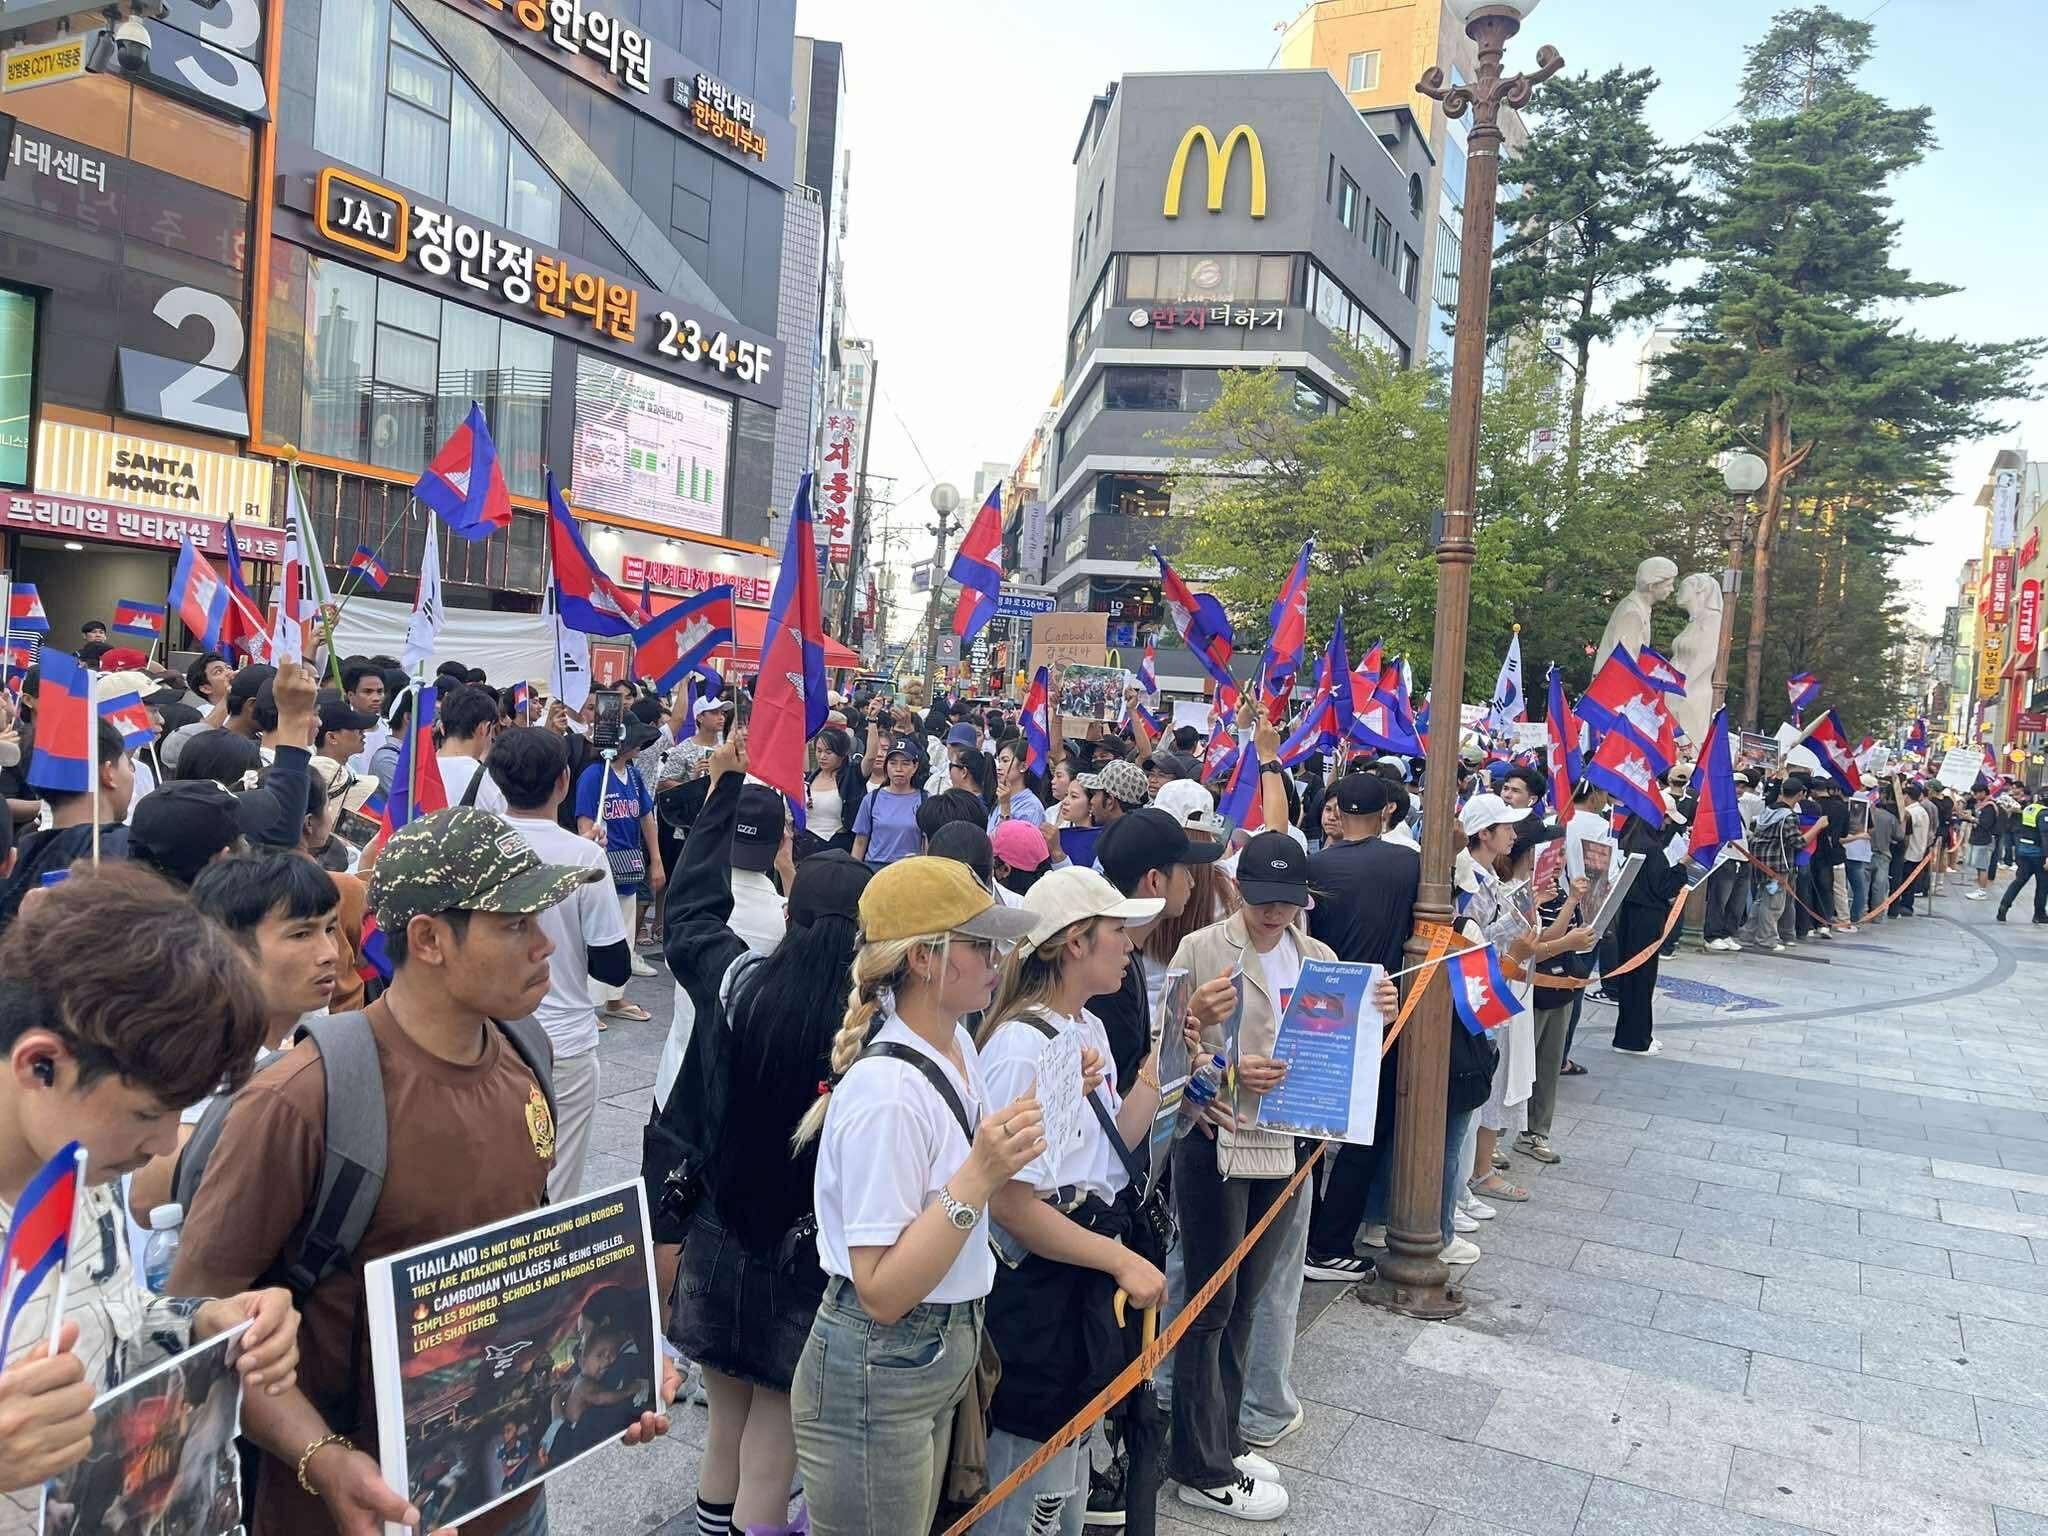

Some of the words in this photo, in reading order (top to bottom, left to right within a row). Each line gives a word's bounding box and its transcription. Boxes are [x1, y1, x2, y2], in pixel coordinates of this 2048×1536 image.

[697, 73, 755, 129] 한방내과
[695, 100, 767, 161] 한방피부과
[413, 204, 638, 343] 정안정한의원
[107, 471, 200, 501] MONICA
[115, 450, 194, 479] SANTA
[7, 497, 108, 534] 프리미엄
[223, 535, 252, 554] 하
[244, 503, 261, 518] B1
[2020, 589, 2035, 643] BUTTER
[406, 1246, 478, 1284] THAILAND
[480, 1248, 490, 1260] IS
[491, 1241, 508, 1257] NOT
[510, 1233, 531, 1250] ONLY
[533, 1220, 574, 1244] ATTACKING
[575, 1213, 591, 1229] OUR
[591, 1203, 624, 1223] BORDERS
[412, 1281, 437, 1300] THEY
[439, 1272, 459, 1290] ARE
[460, 1257, 507, 1283] ATTACKING
[509, 1252, 527, 1269] OUR
[412, 1310, 457, 1337] TEMPLES
[502, 1280, 541, 1304] SCHOOLS
[543, 1274, 560, 1290] AND
[561, 1260, 595, 1281] PAGODAS
[596, 1244, 635, 1268] DESTROYED
[433, 1277, 500, 1312] CAMBODIAN
[502, 1259, 551, 1287] VILLAGES
[553, 1255, 567, 1270] ARE
[569, 1247, 591, 1263] BEING
[413, 1332, 442, 1353] LIVES
[444, 1313, 499, 1342] SHATTERED.
